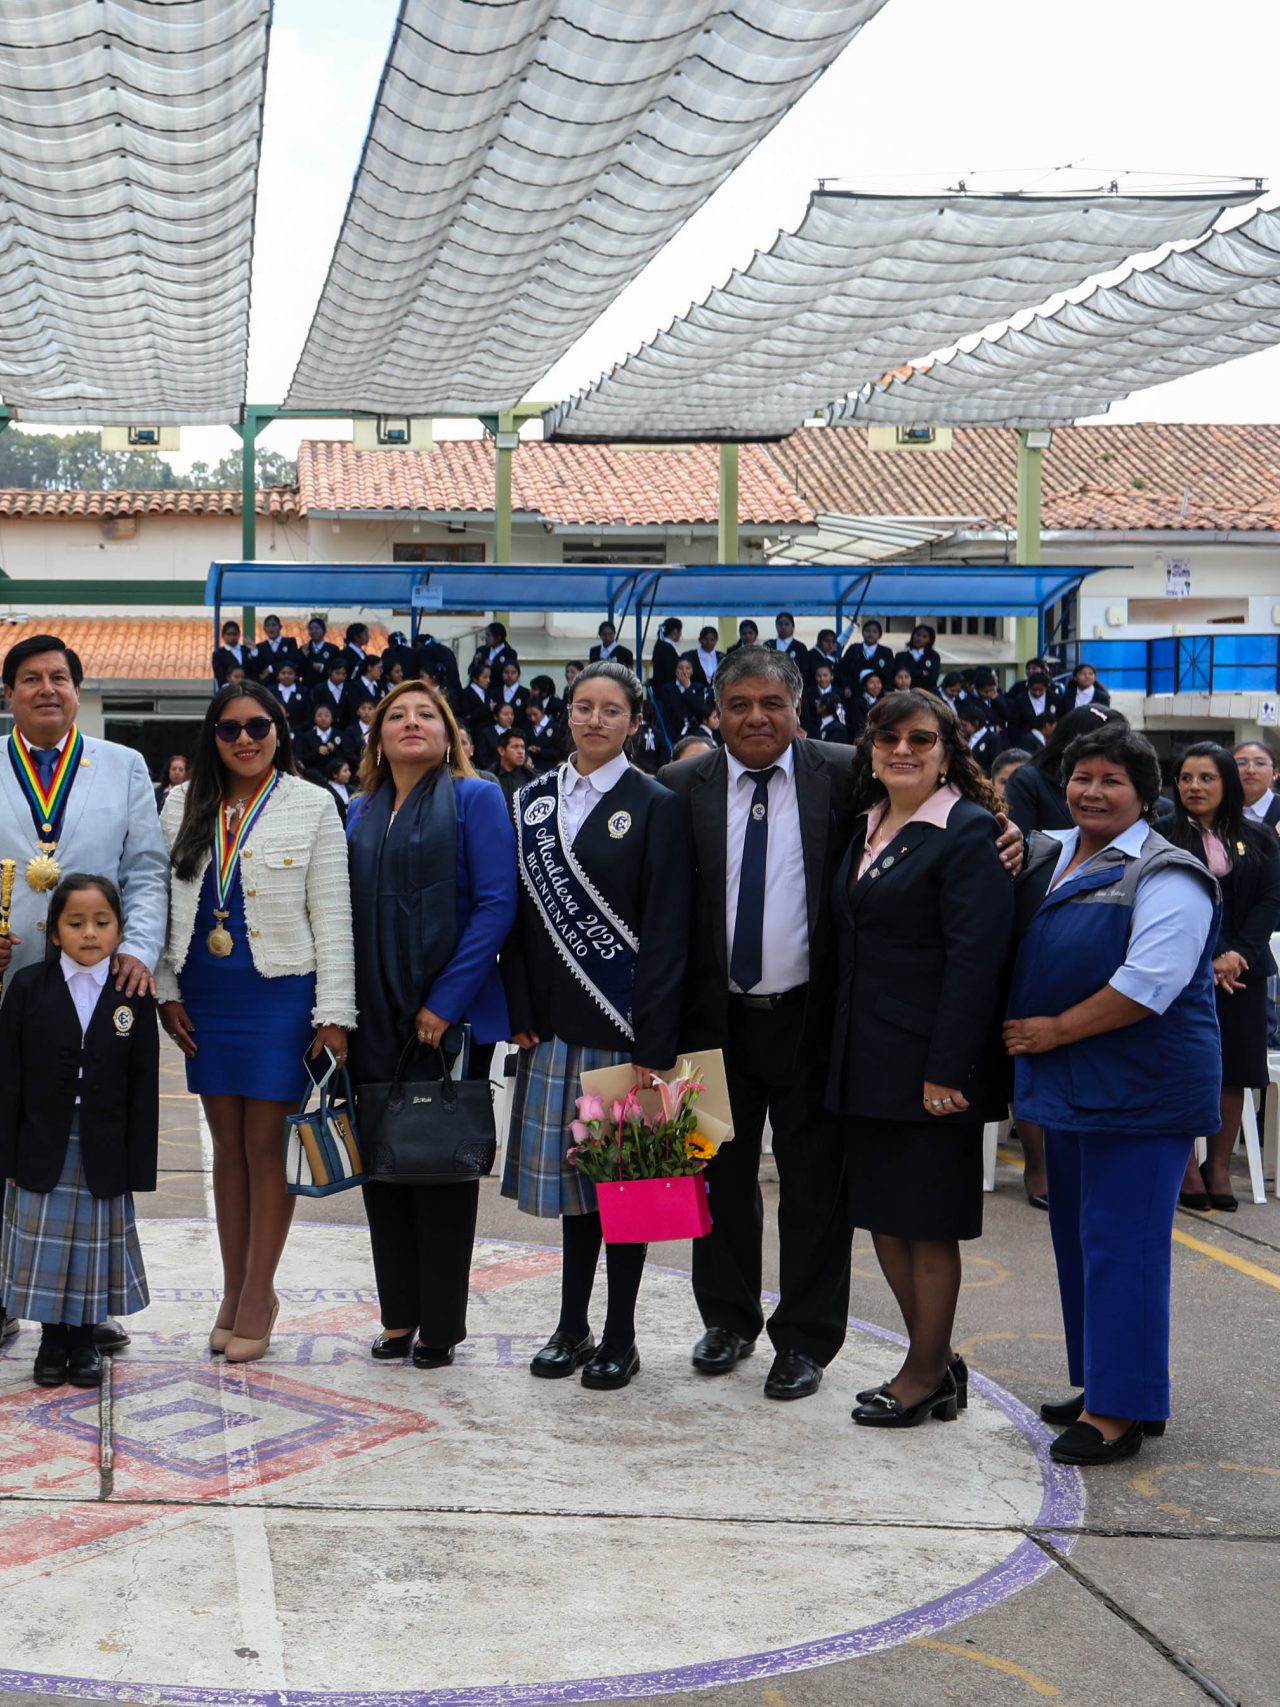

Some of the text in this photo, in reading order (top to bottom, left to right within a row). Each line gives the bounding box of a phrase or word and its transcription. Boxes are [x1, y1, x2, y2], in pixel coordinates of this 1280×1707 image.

[526, 851, 588, 958] BICENTENARIO
[535, 827, 579, 916] Alcaldesa
[576, 914, 624, 960] 2025
